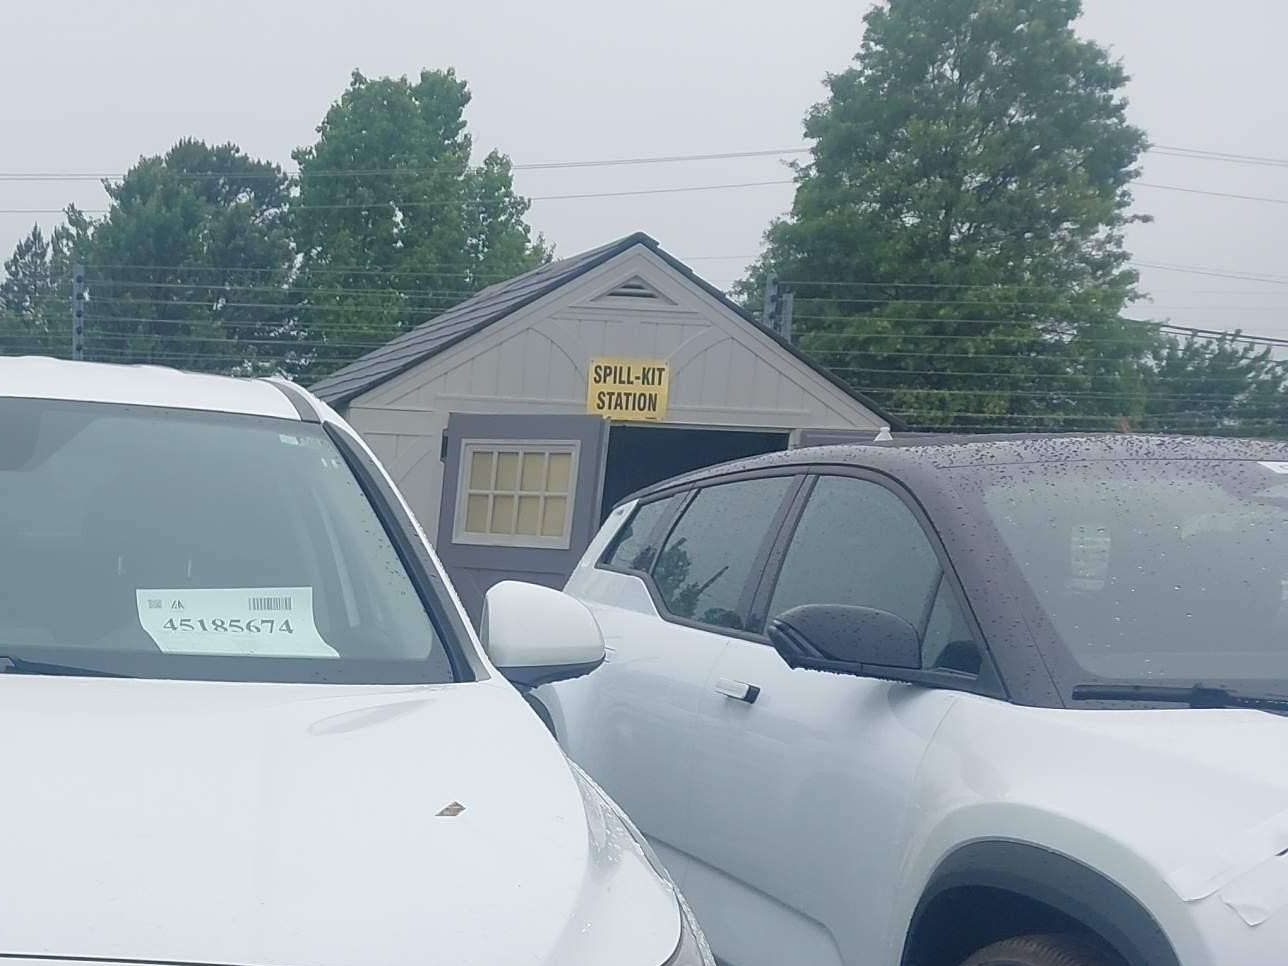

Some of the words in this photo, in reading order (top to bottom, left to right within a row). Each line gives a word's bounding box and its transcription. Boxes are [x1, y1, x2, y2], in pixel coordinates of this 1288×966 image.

[593, 364, 666, 386] SPILL-KIT
[596, 391, 658, 412] STATION
[162, 617, 294, 634] 45185674
